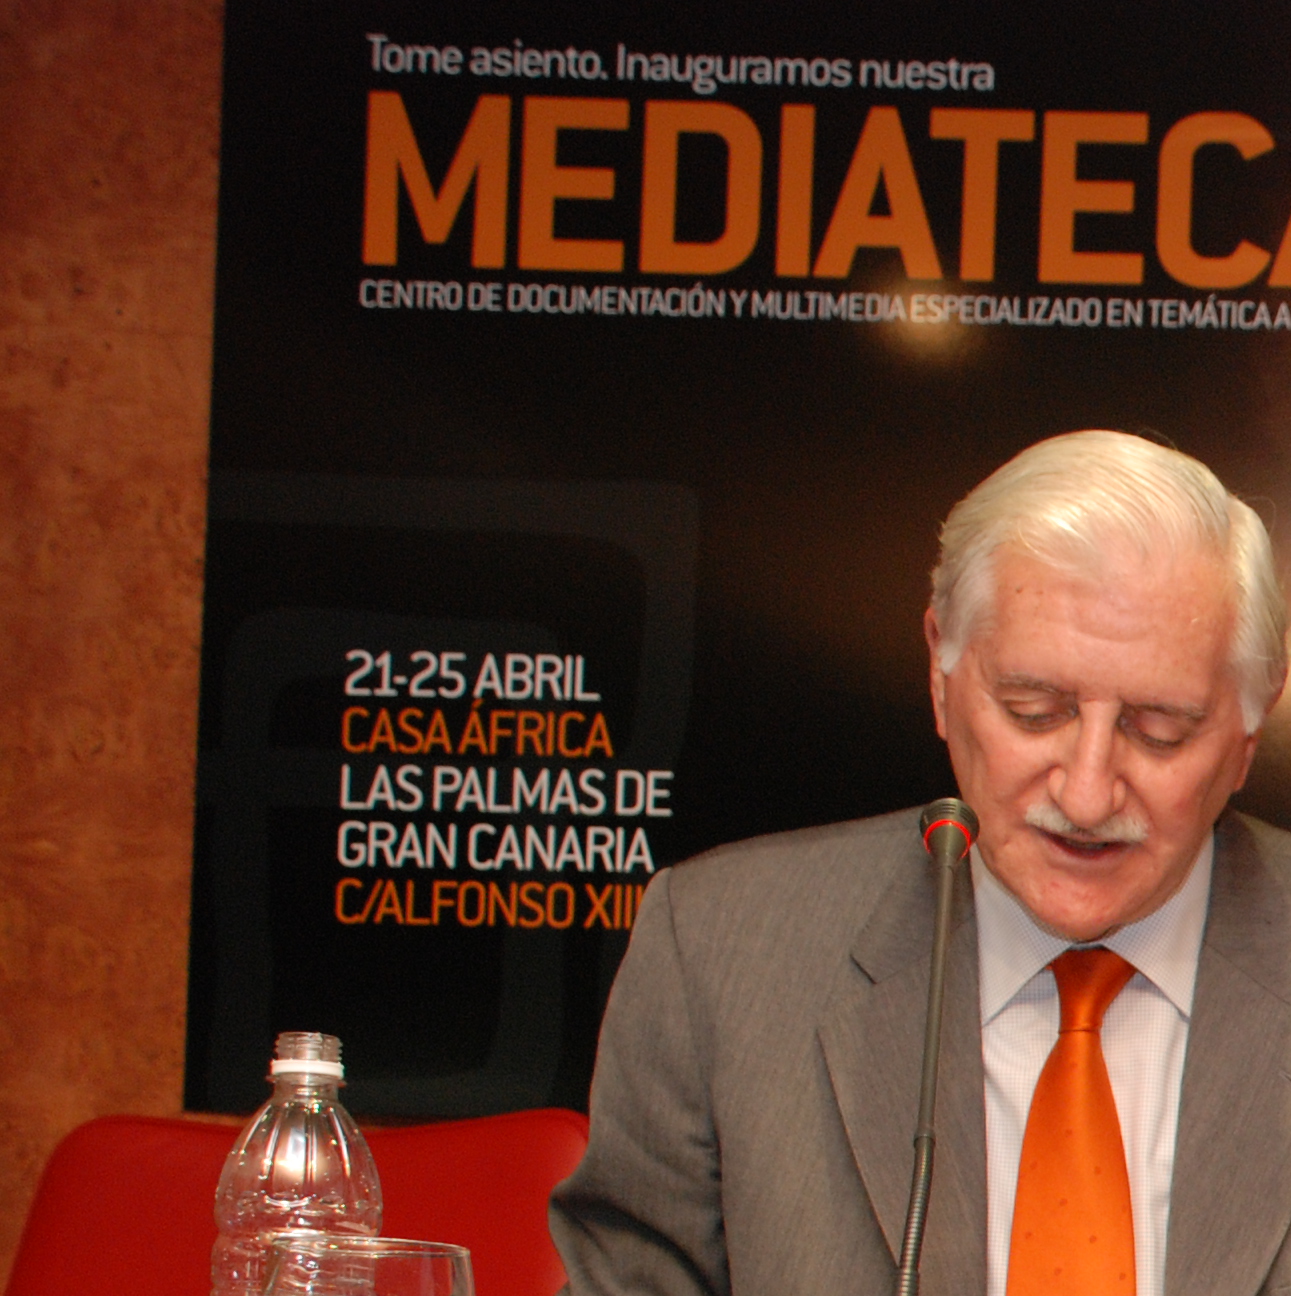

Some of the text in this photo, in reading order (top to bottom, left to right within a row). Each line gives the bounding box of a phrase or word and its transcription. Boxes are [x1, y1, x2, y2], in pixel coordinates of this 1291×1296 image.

[366, 33, 995, 95] Tome asiento. Inauguramos nuestra
[359, 278, 463, 311] CENTRO
[467, 282, 507, 312] DE
[510, 282, 725, 318] DOCUMENTACIÓN
[728, 289, 749, 318] Y
[751, 290, 907, 323] MULTIMEDIA
[910, 294, 1103, 327] ESPECIALIZADO
[1106, 299, 1145, 328] EN
[1148, 294, 1273, 330] TEMÁTICA
[344, 649, 601, 701] 21-25 ABRIL
[341, 698, 614, 758] CASA ÁFRICA
[339, 763, 675, 817] LAS PALMAS DE
[337, 820, 655, 873] GRAN CANARIA
[334, 878, 575, 930] C/ALFONSO
